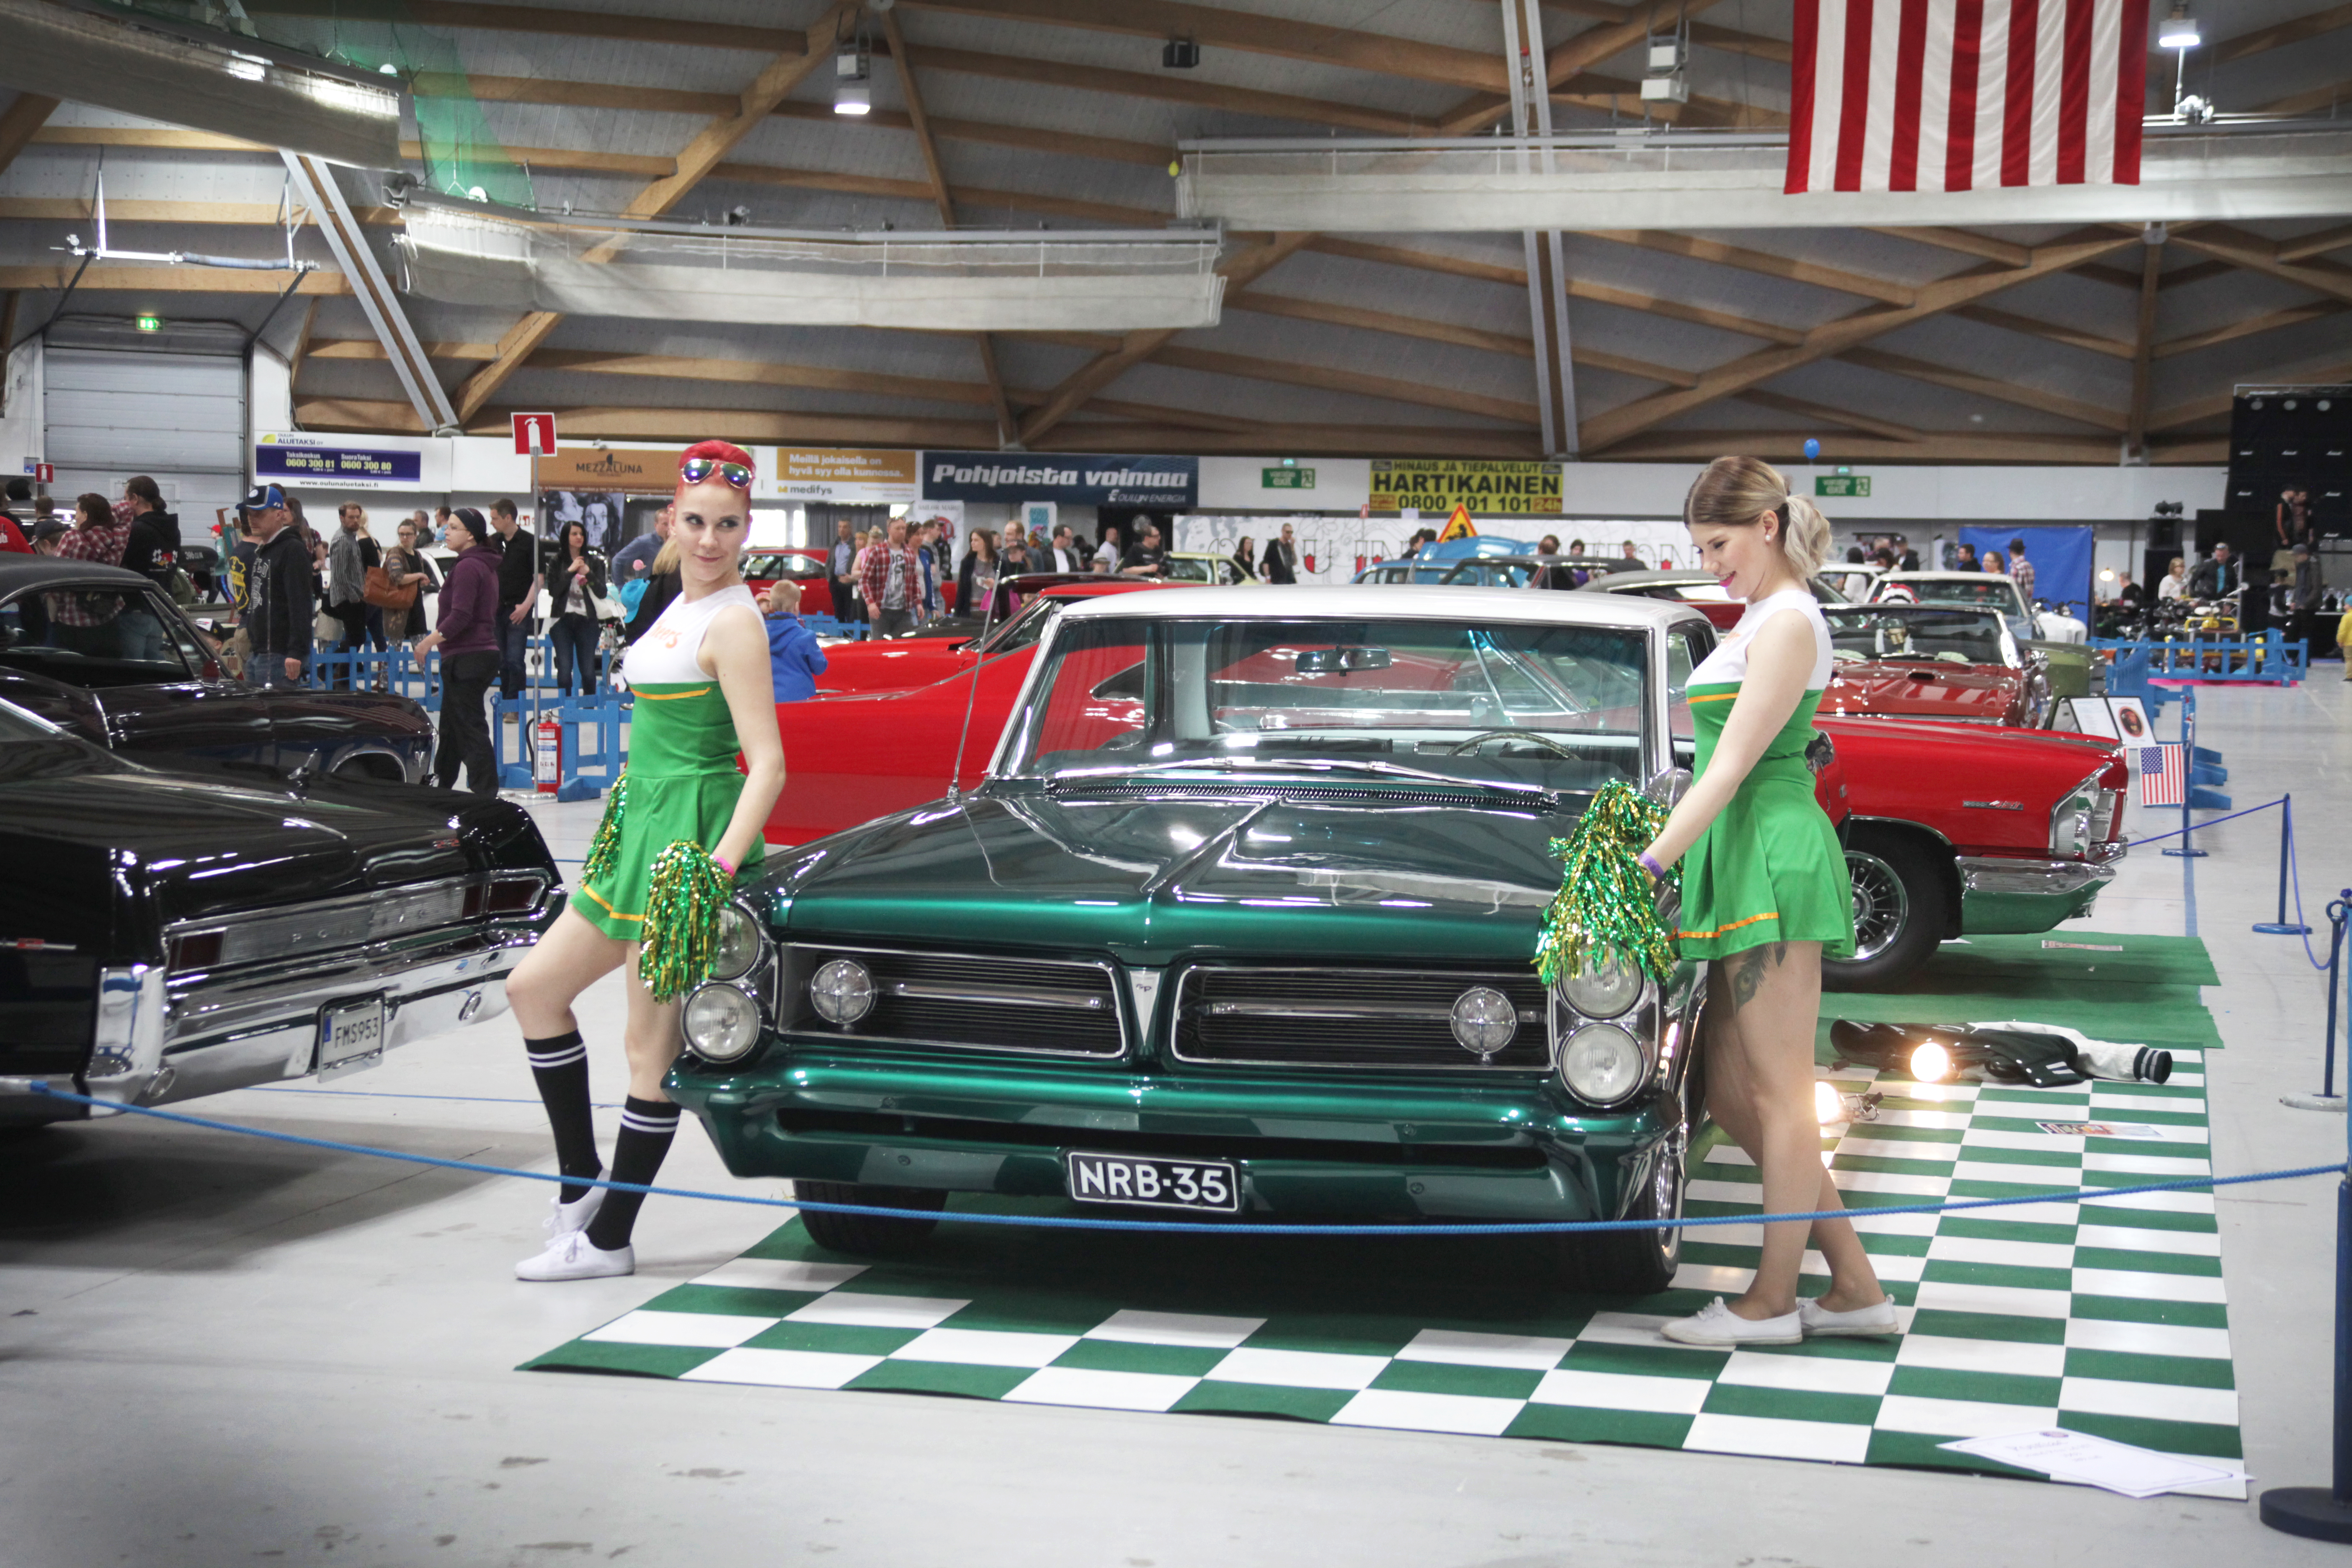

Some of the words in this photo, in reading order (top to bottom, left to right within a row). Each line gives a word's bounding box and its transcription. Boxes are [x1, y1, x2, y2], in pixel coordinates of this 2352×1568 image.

[286, 459, 307, 467] 0600
[308, 459, 323, 468] 300
[341, 461, 361, 469] 0600
[364, 462, 379, 470] 300
[381, 462, 392, 470] 80
[789, 454, 819, 464] Meillä
[821, 455, 867, 465] jokaisella
[576, 462, 642, 474] MEZZALUNA
[789, 466, 812, 476] hyvä
[815, 468, 832, 477] syy
[834, 467, 851, 476] olla
[854, 467, 903, 477] kunnossa.
[1394, 461, 1439, 471] HINAUS
[1444, 462, 1457, 471] JA
[1462, 462, 1539, 473] TIEPALVELUT
[933, 464, 1078, 487] Pohjoista
[1086, 468, 1188, 487] voimaa
[790, 485, 832, 495] medifys
[1375, 474, 1558, 495] HARTIKAINEN
[1149, 494, 1185, 503] ENERGIA
[1398, 495, 1446, 510] 0800
[1498, 496, 1531, 511] 101
[1534, 498, 1562, 512] 24h
[335, 1016, 378, 1048] FMS953
[1079, 1161, 1227, 1203] NRB-35
